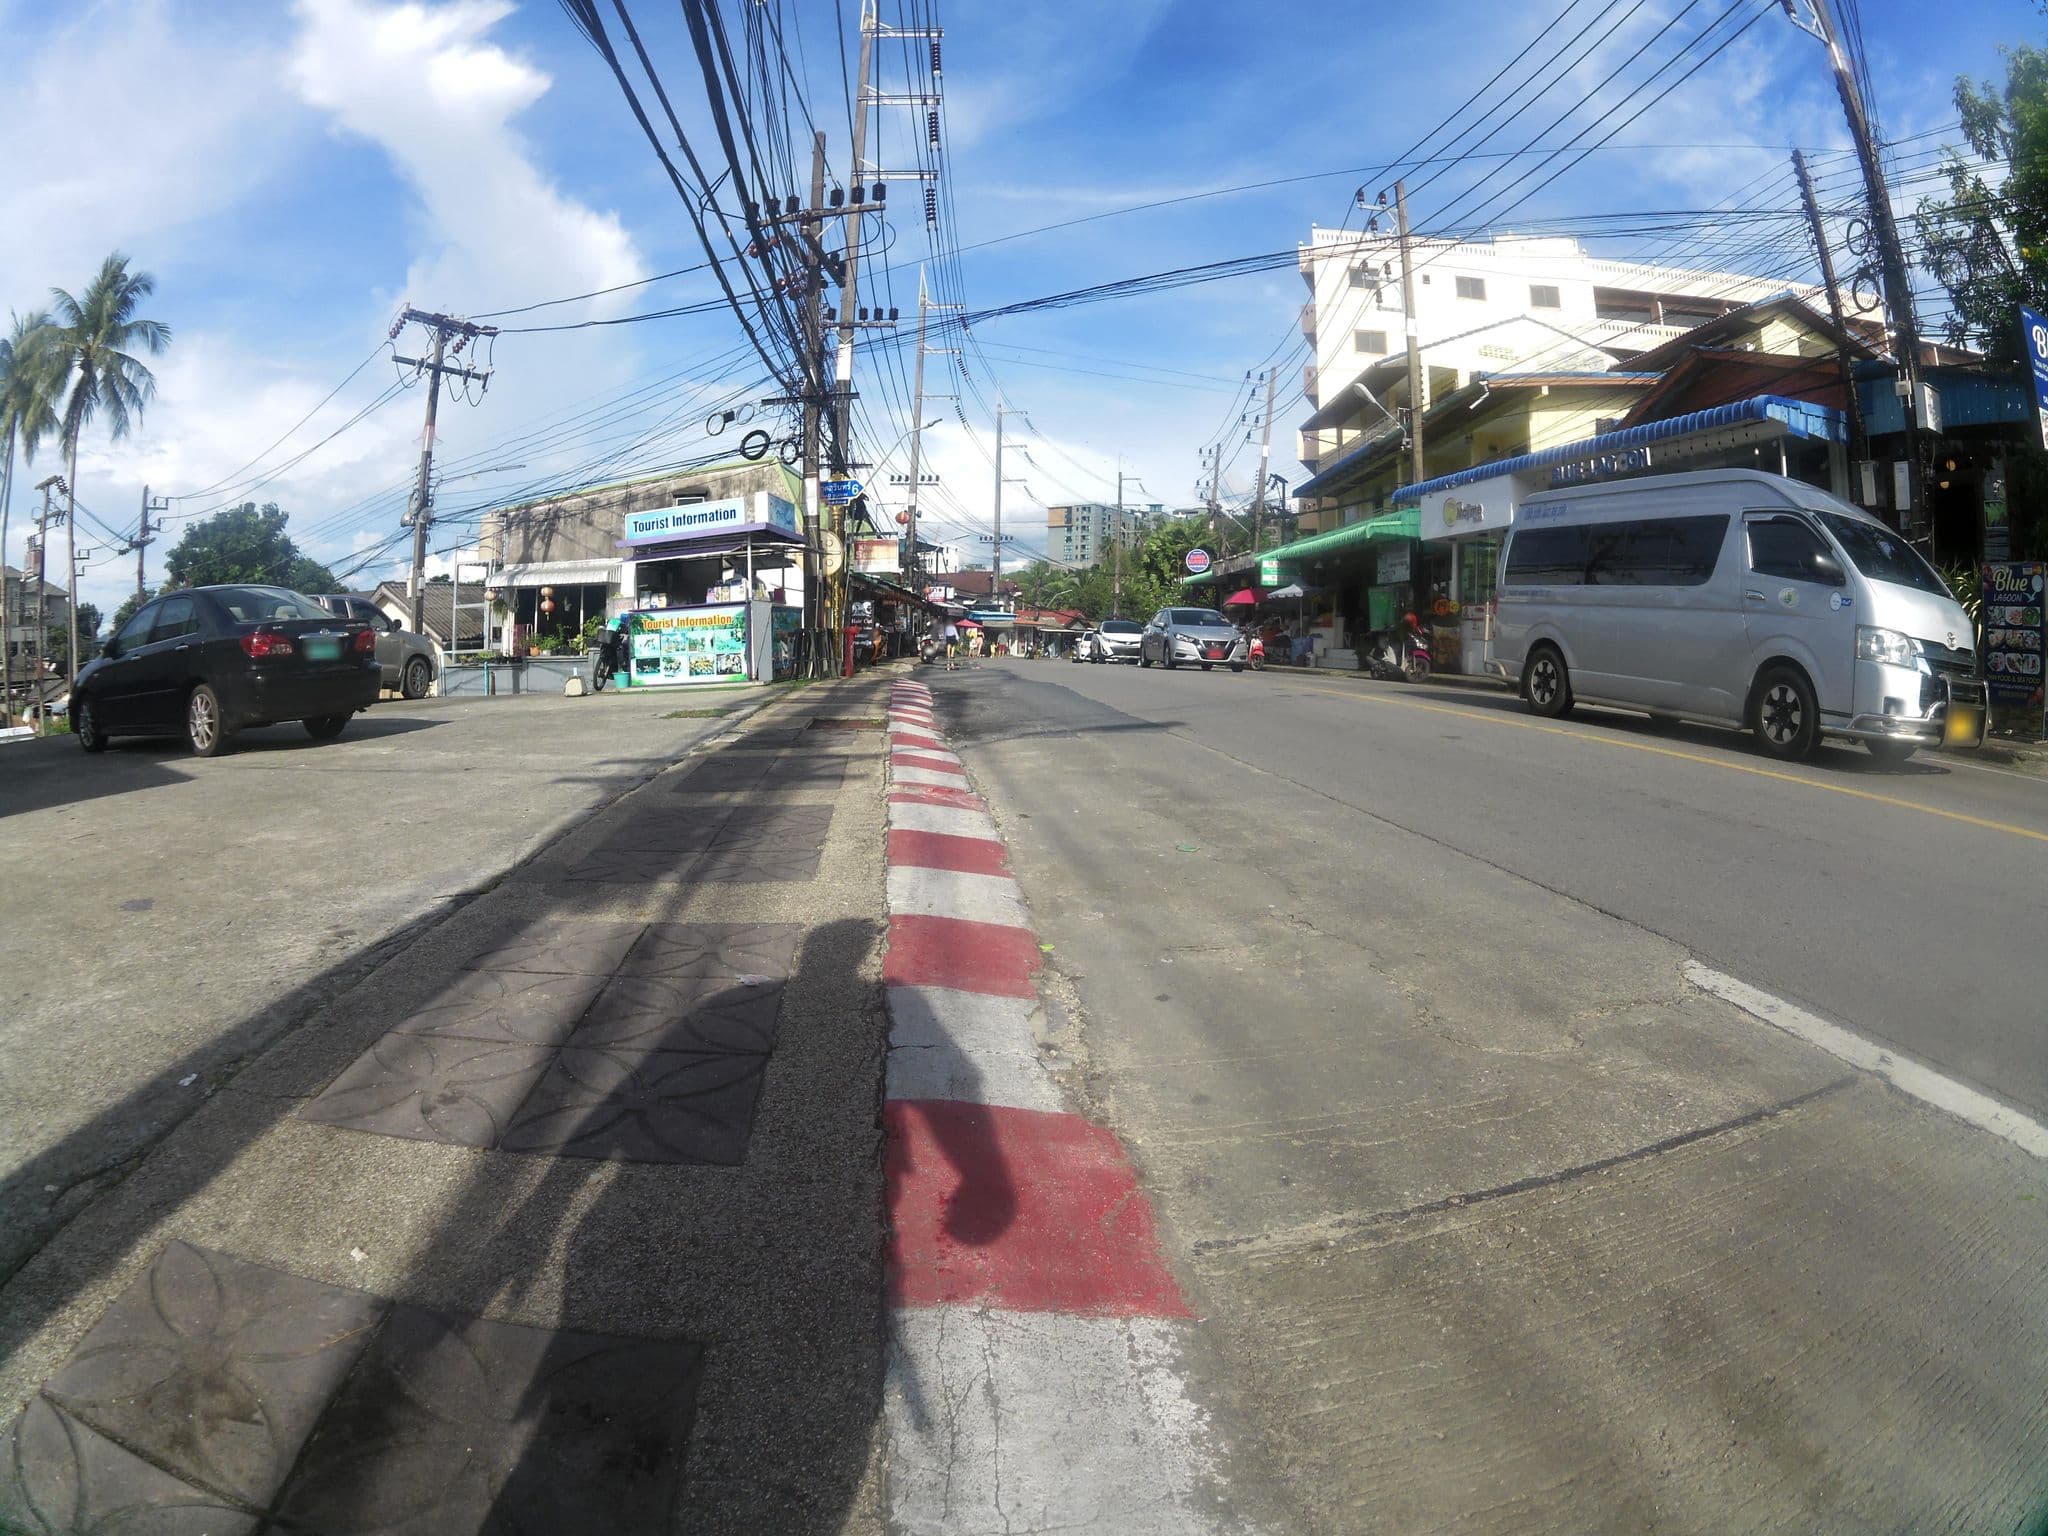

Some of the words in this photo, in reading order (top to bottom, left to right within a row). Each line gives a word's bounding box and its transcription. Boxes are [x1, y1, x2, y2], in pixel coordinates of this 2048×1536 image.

[1552, 461, 1586, 481] BLUE
[1590, 447, 1651, 477] LAGOON
[852, 483, 859, 495] 6
[633, 517, 669, 533] Tourist
[672, 508, 737, 527] Information
[1993, 568, 2028, 591] Blue
[1993, 592, 2023, 602] LAGOON
[642, 618, 674, 629] Tourist
[677, 614, 732, 628] Information
